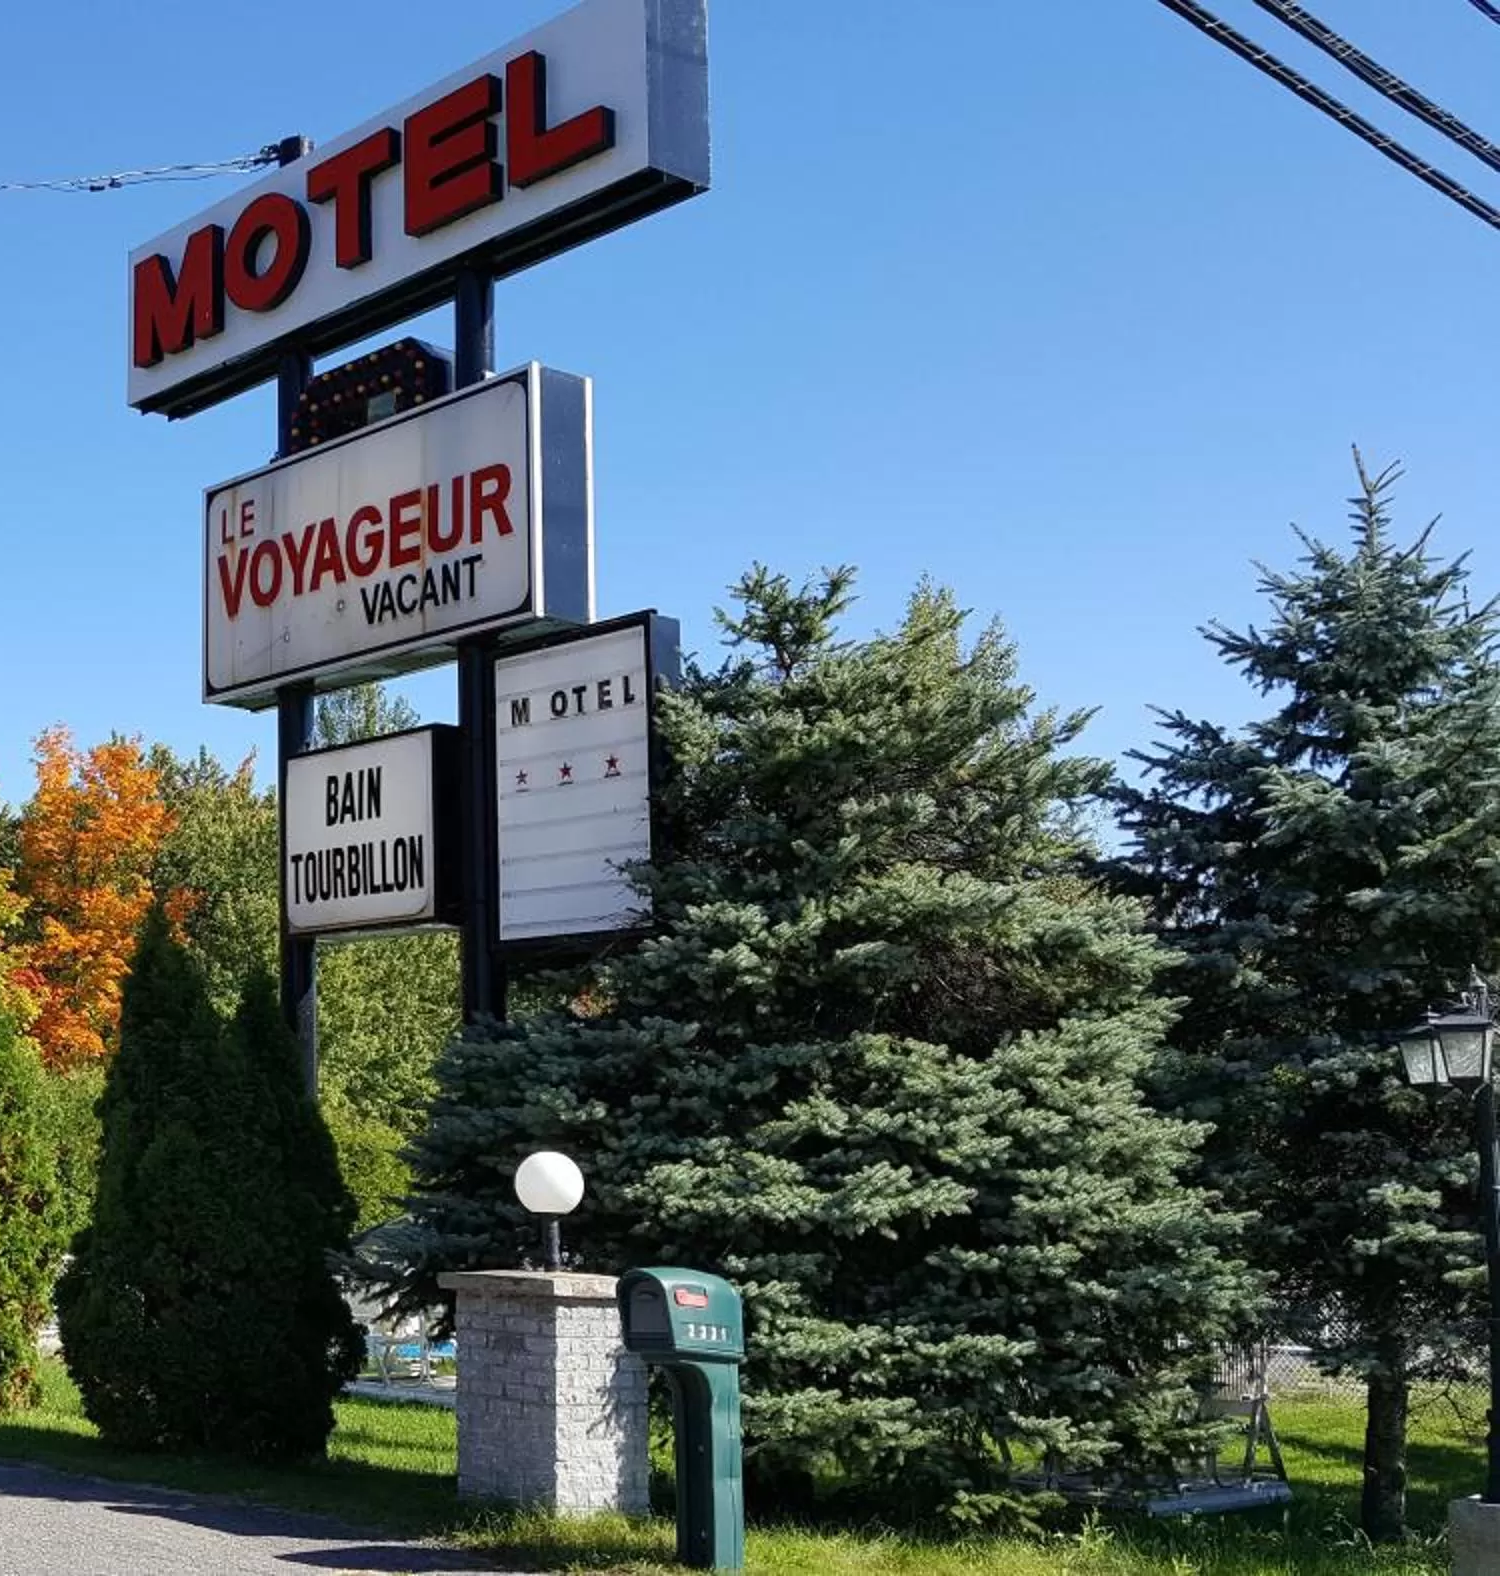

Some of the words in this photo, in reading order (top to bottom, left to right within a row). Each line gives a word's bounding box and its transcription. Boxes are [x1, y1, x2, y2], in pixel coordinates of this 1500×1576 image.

[133, 49, 616, 369] MOTEL
[217, 462, 514, 621] VOYAGEUR
[221, 499, 254, 545] LE
[360, 554, 483, 625] VACANT
[325, 766, 383, 827] BAIN
[291, 835, 425, 905] TOURBILLON
